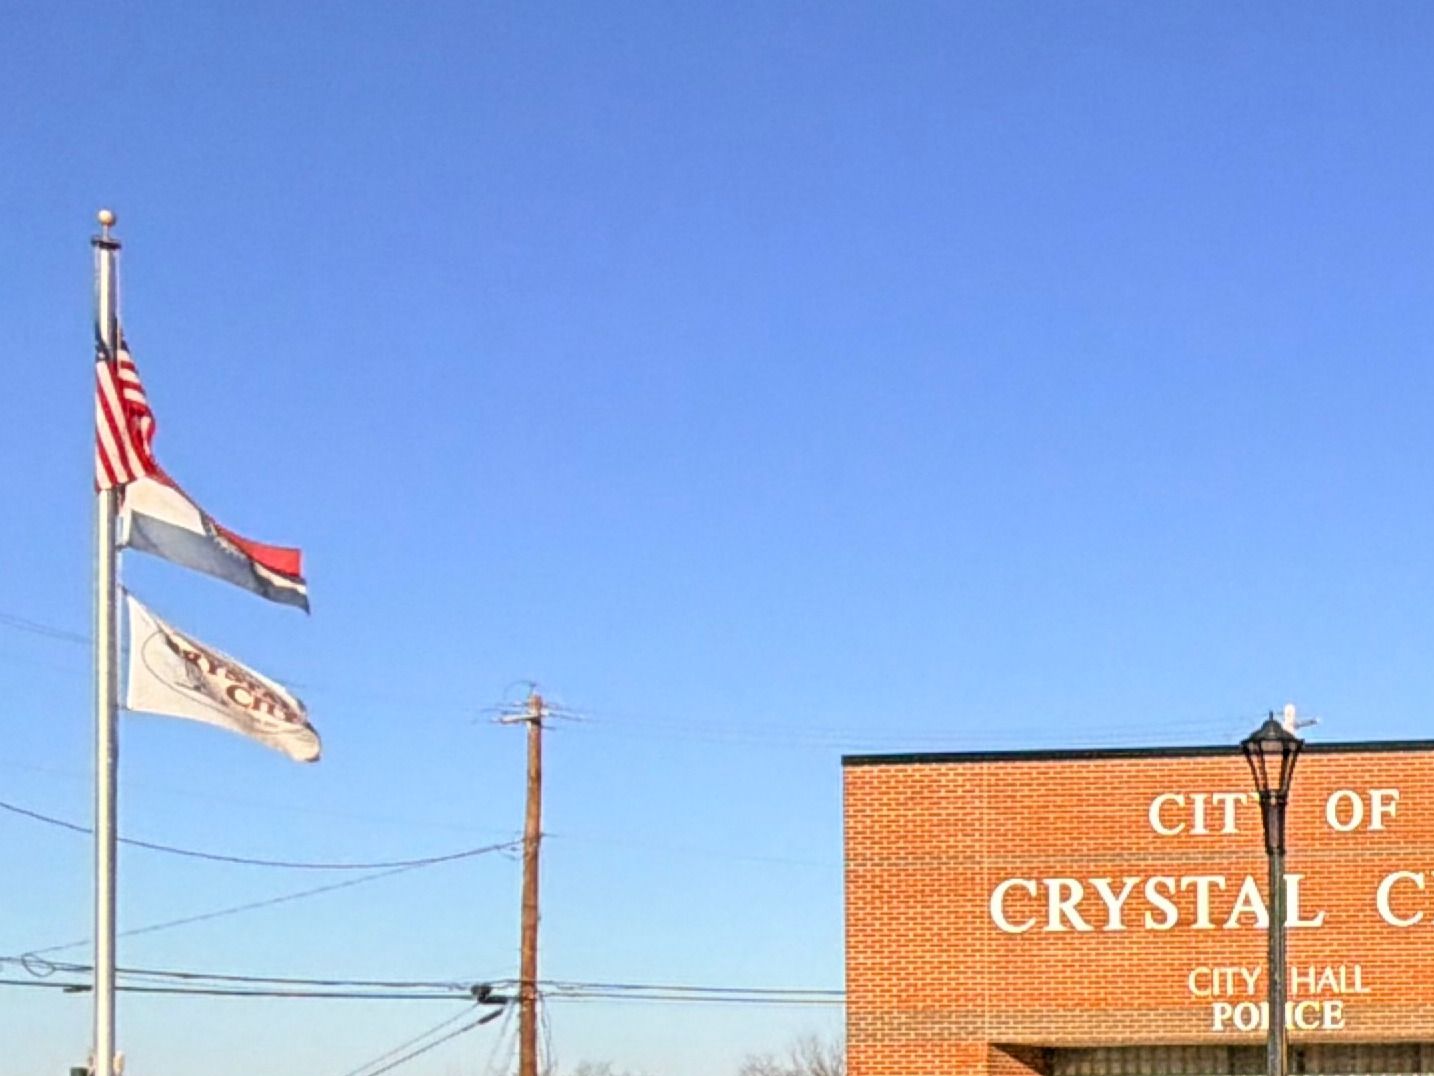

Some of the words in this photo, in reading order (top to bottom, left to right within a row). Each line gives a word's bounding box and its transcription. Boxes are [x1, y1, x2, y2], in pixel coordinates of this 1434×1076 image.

[1149, 791, 1262, 836] CIT
[1325, 788, 1400, 832] OF
[989, 873, 1326, 933] CRYSTAL
[1188, 966, 1263, 996] CITY
[1290, 964, 1371, 995] HALL
